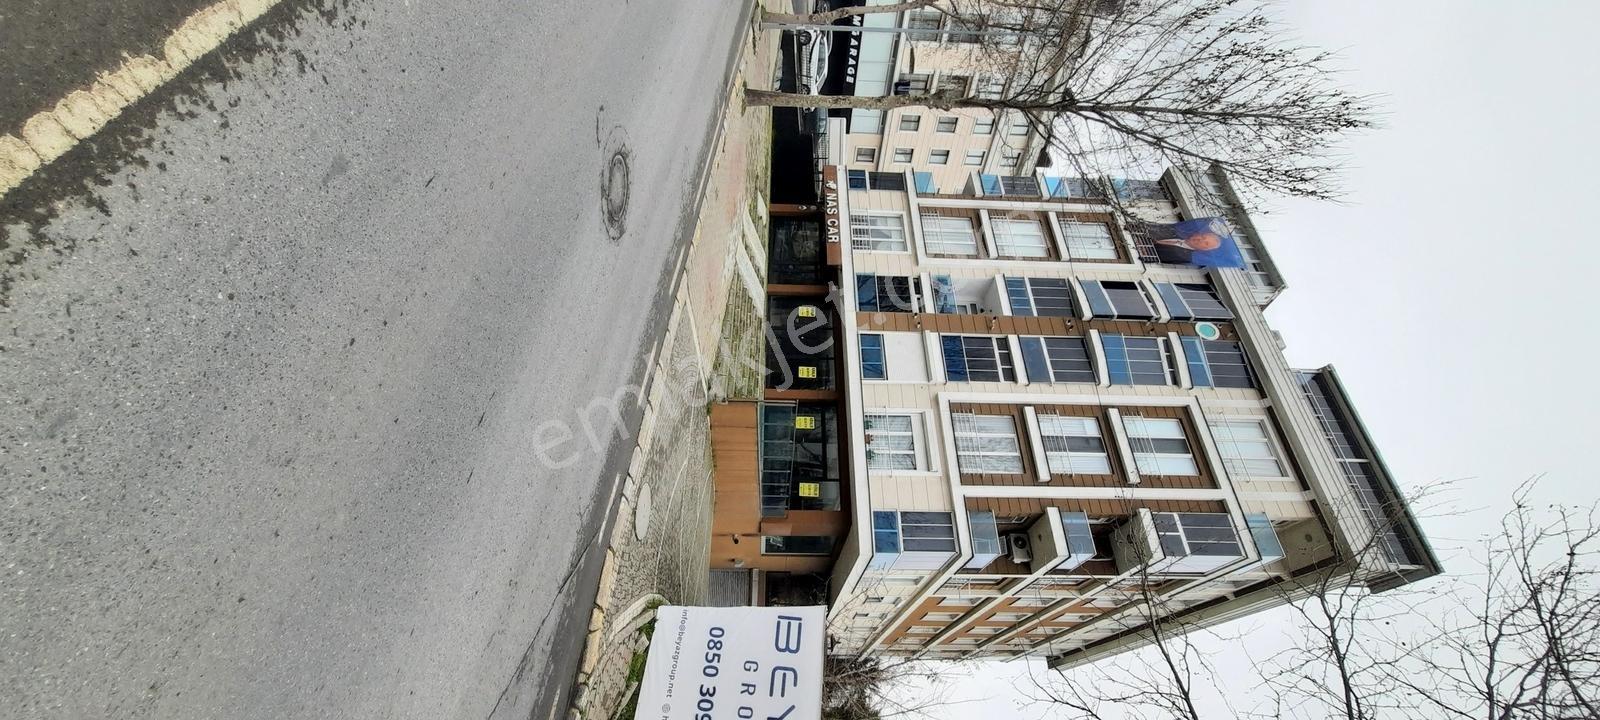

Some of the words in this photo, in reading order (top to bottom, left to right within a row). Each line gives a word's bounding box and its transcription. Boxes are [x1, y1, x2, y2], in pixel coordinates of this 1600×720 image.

[826, 193, 838, 215] NAS
[827, 218, 840, 242] CAR
[666, 609, 688, 698] info@beyazgroup.net
[702, 626, 725, 678] 0850
[737, 660, 759, 720] GRO
